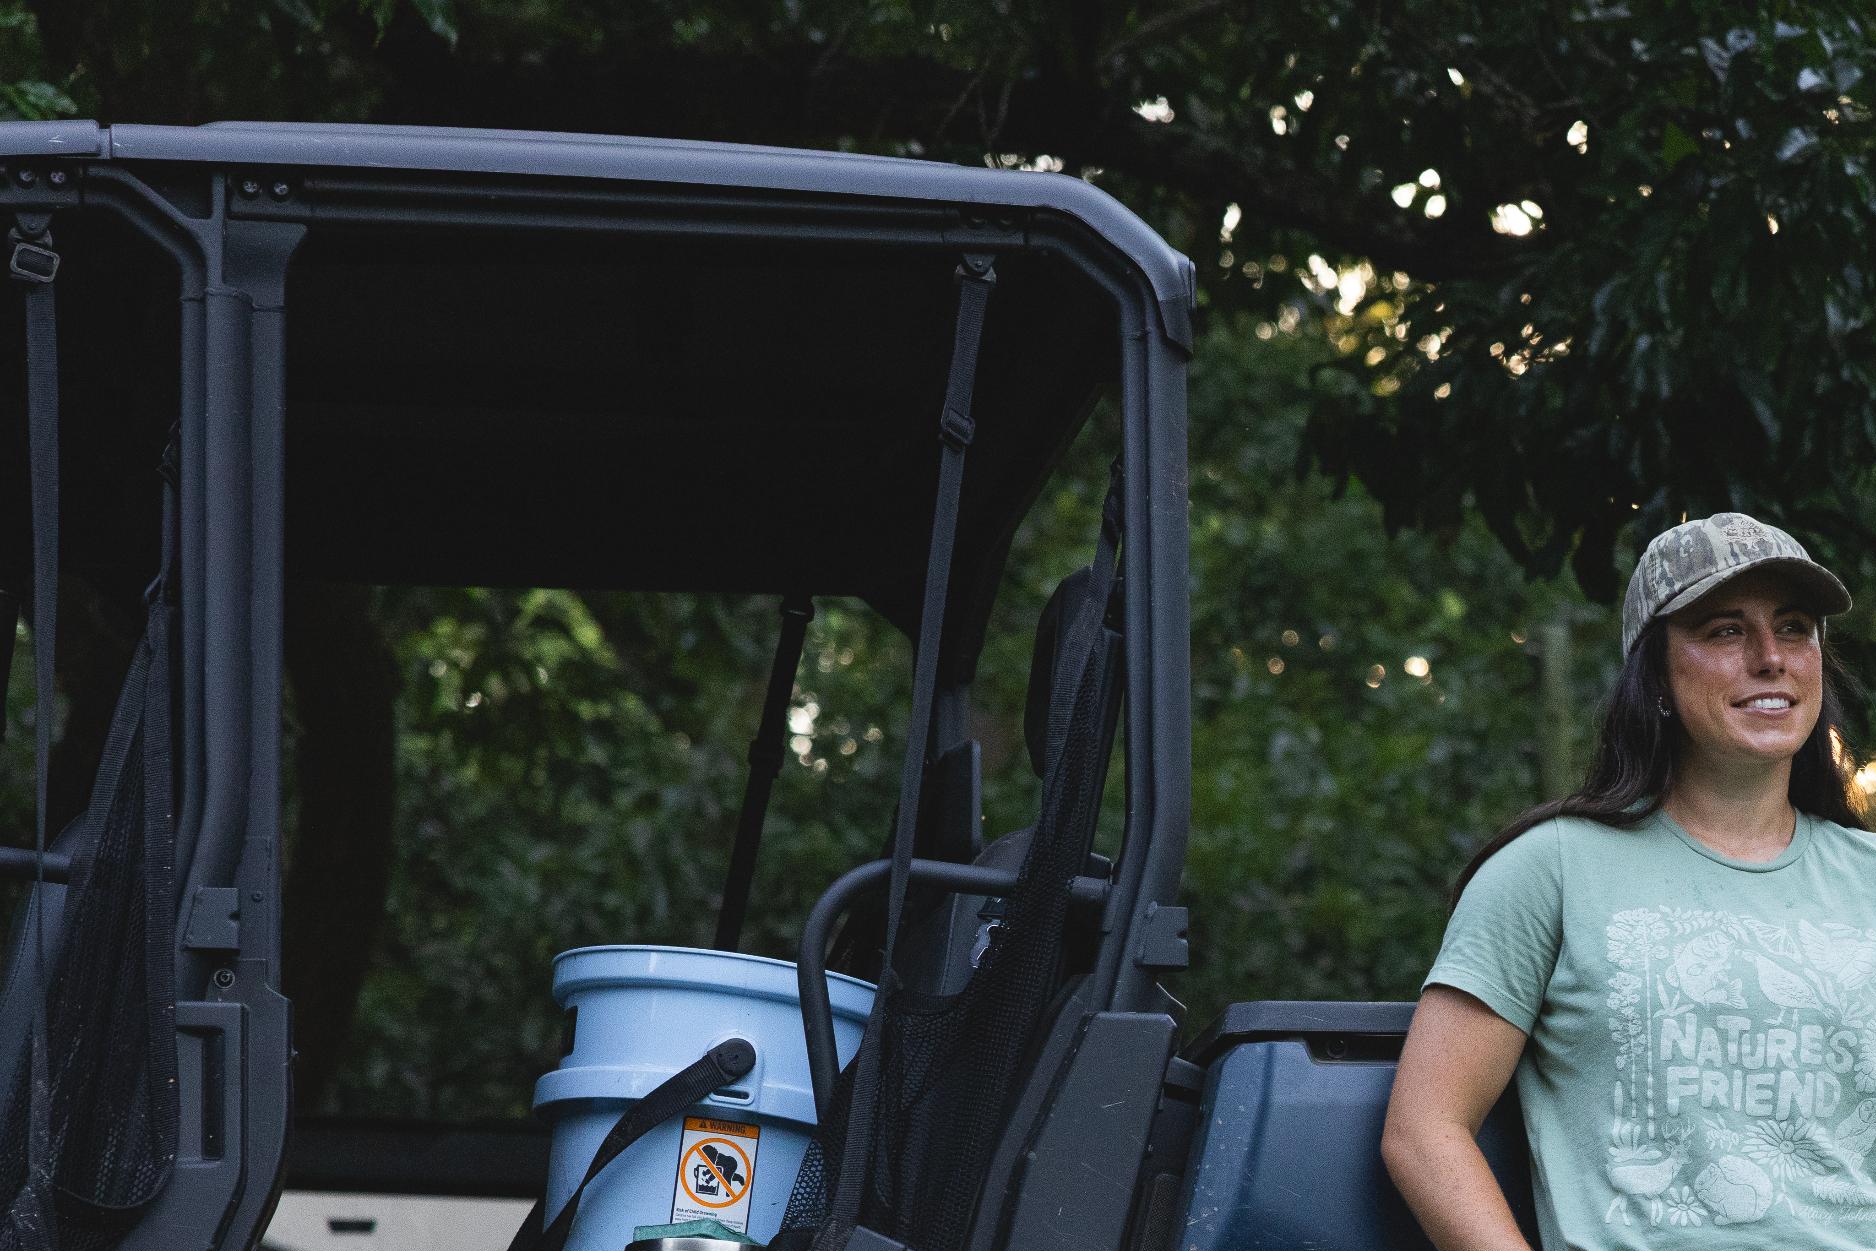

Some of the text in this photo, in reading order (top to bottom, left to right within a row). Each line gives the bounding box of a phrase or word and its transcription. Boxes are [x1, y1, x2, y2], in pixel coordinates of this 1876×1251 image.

[1660, 1014, 1860, 1074] NATURE'S
[1666, 1066, 1841, 1120] FRIEND
[709, 1120, 746, 1134] WARNING
